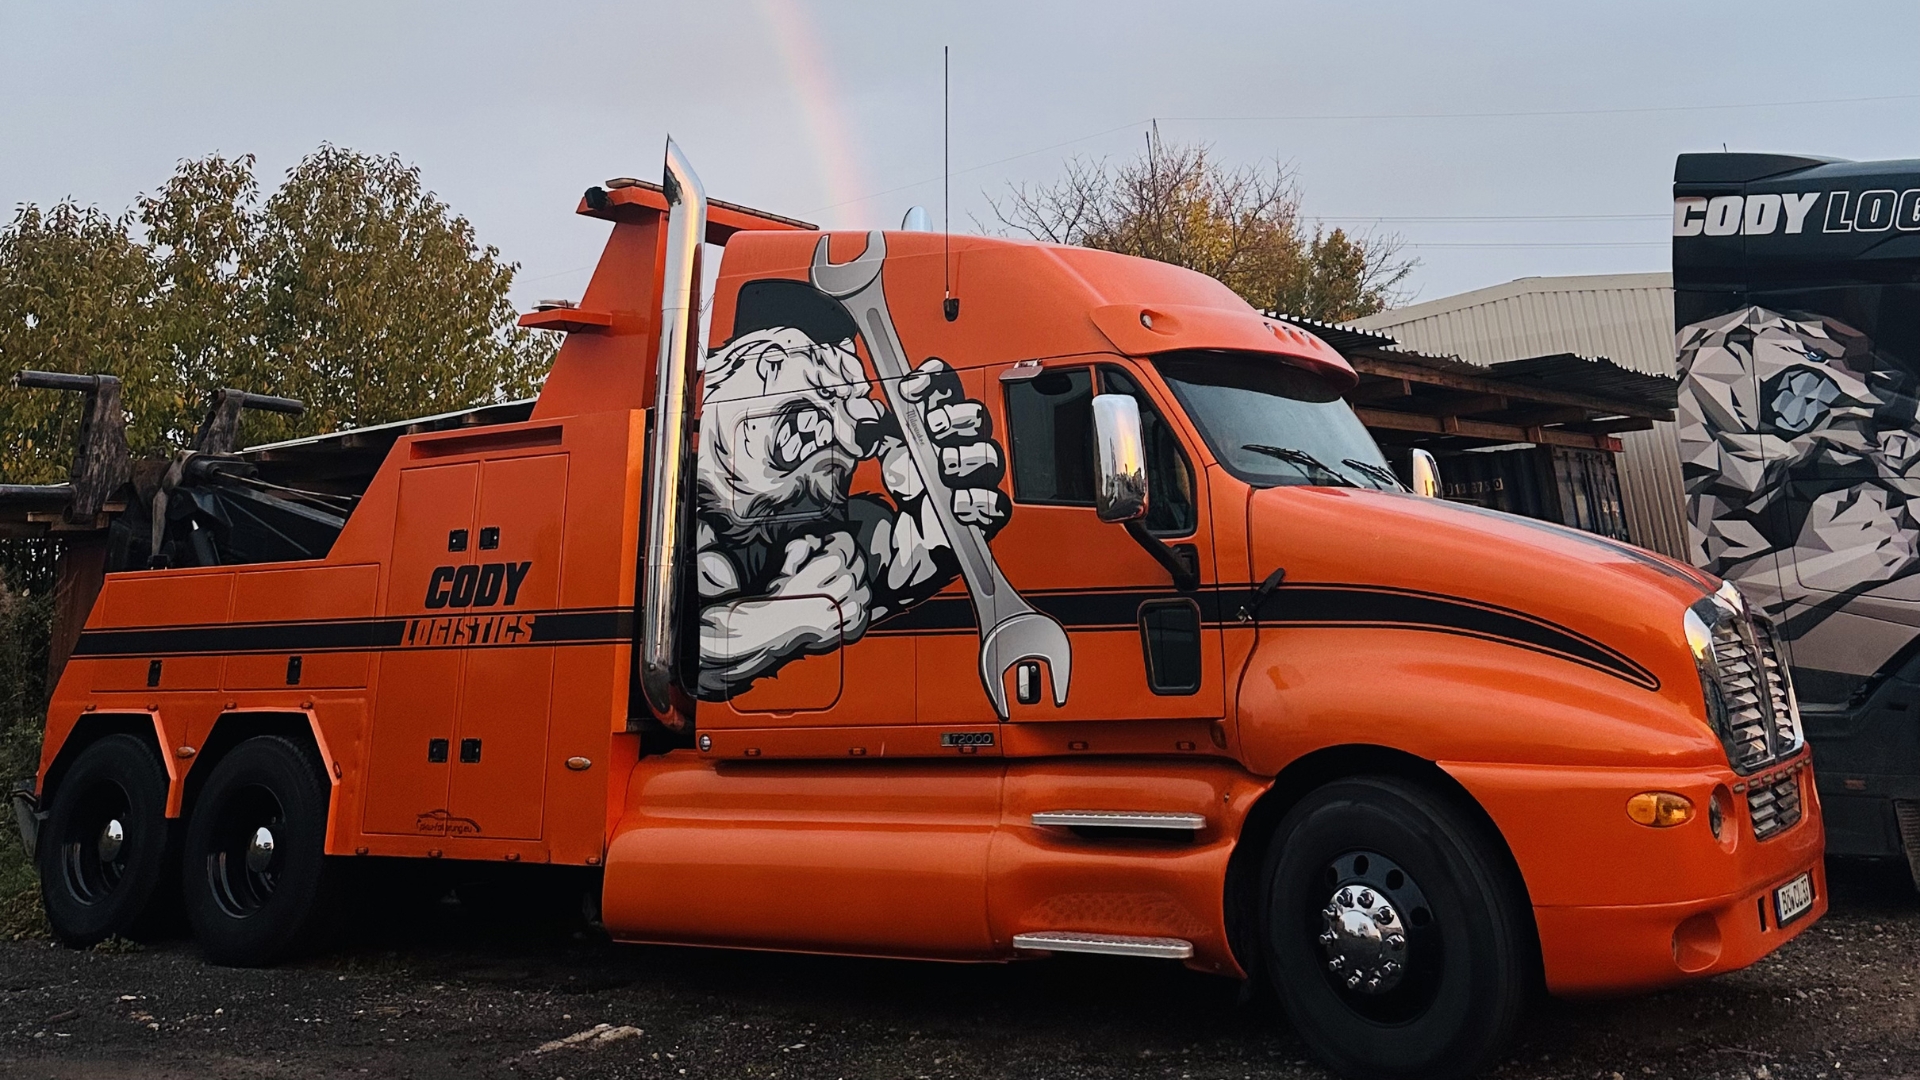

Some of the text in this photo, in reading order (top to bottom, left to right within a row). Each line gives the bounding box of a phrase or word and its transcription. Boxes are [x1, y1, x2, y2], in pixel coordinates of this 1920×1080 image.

[1673, 193, 1821, 236] CODY
[424, 561, 532, 609] CODY
[401, 614, 535, 647] LOGISTICS
[951, 734, 992, 744] T2000
